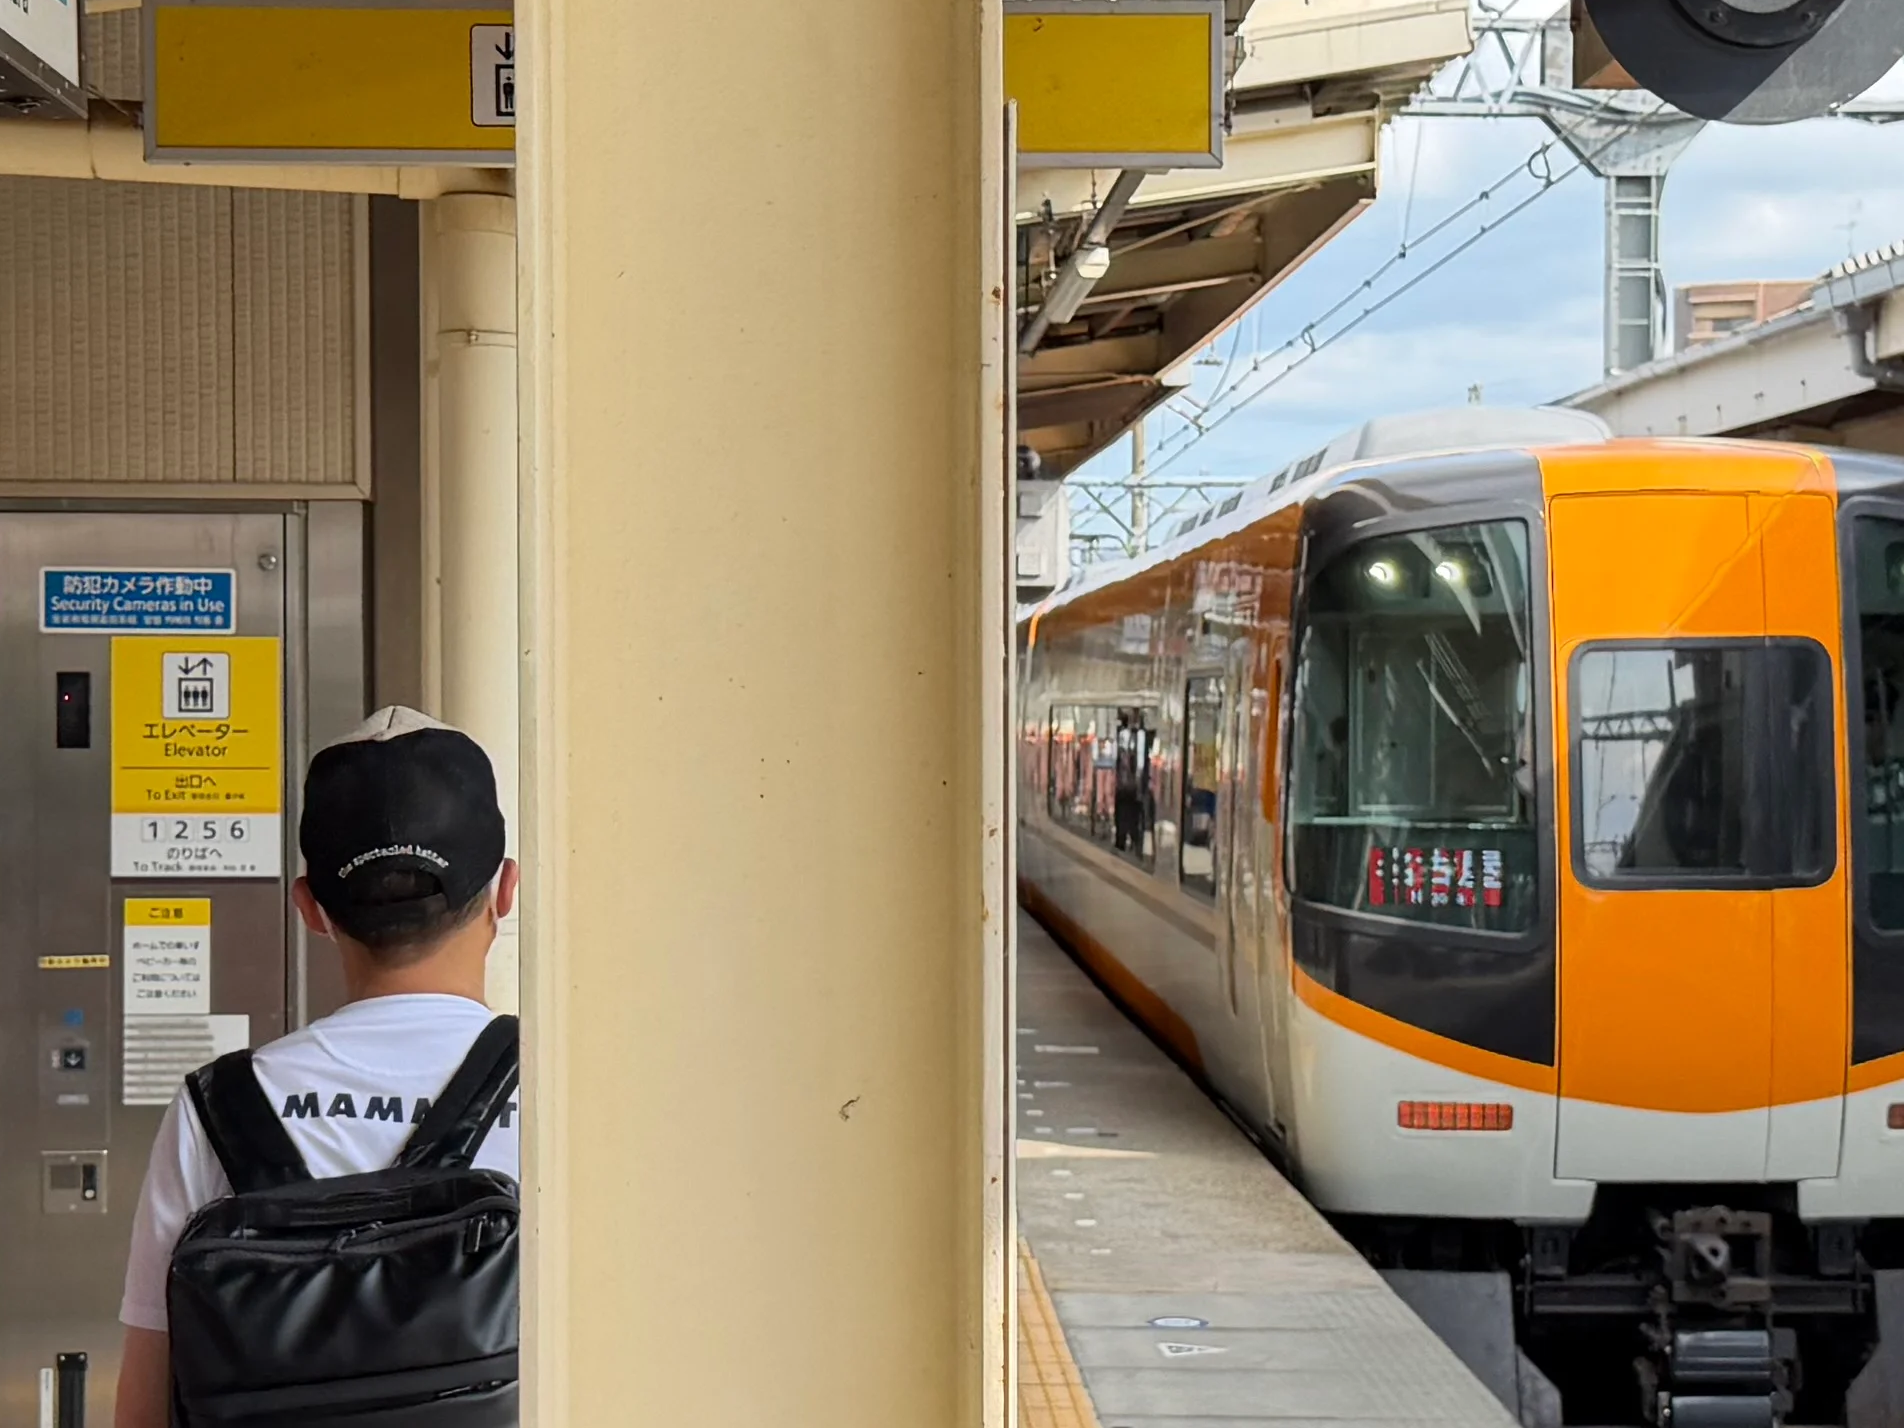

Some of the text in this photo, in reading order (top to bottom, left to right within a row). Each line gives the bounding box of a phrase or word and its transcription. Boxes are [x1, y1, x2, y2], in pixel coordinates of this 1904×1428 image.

[63, 575, 213, 595] 防犯カメラ作動中
[51, 596, 225, 613] Security Cameras in Use
[142, 723, 249, 740] エレベーター
[164, 743, 228, 757] Elevator
[175, 774, 217, 789] 出口へ
[146, 789, 161, 801] To
[165, 789, 186, 800] Exit
[148, 820, 244, 839] 1 2 5 6
[167, 847, 223, 860] のりばへ
[133, 861, 148, 872] To
[152, 861, 183, 872] Track
[282, 1092, 517, 1129] MAMMT
